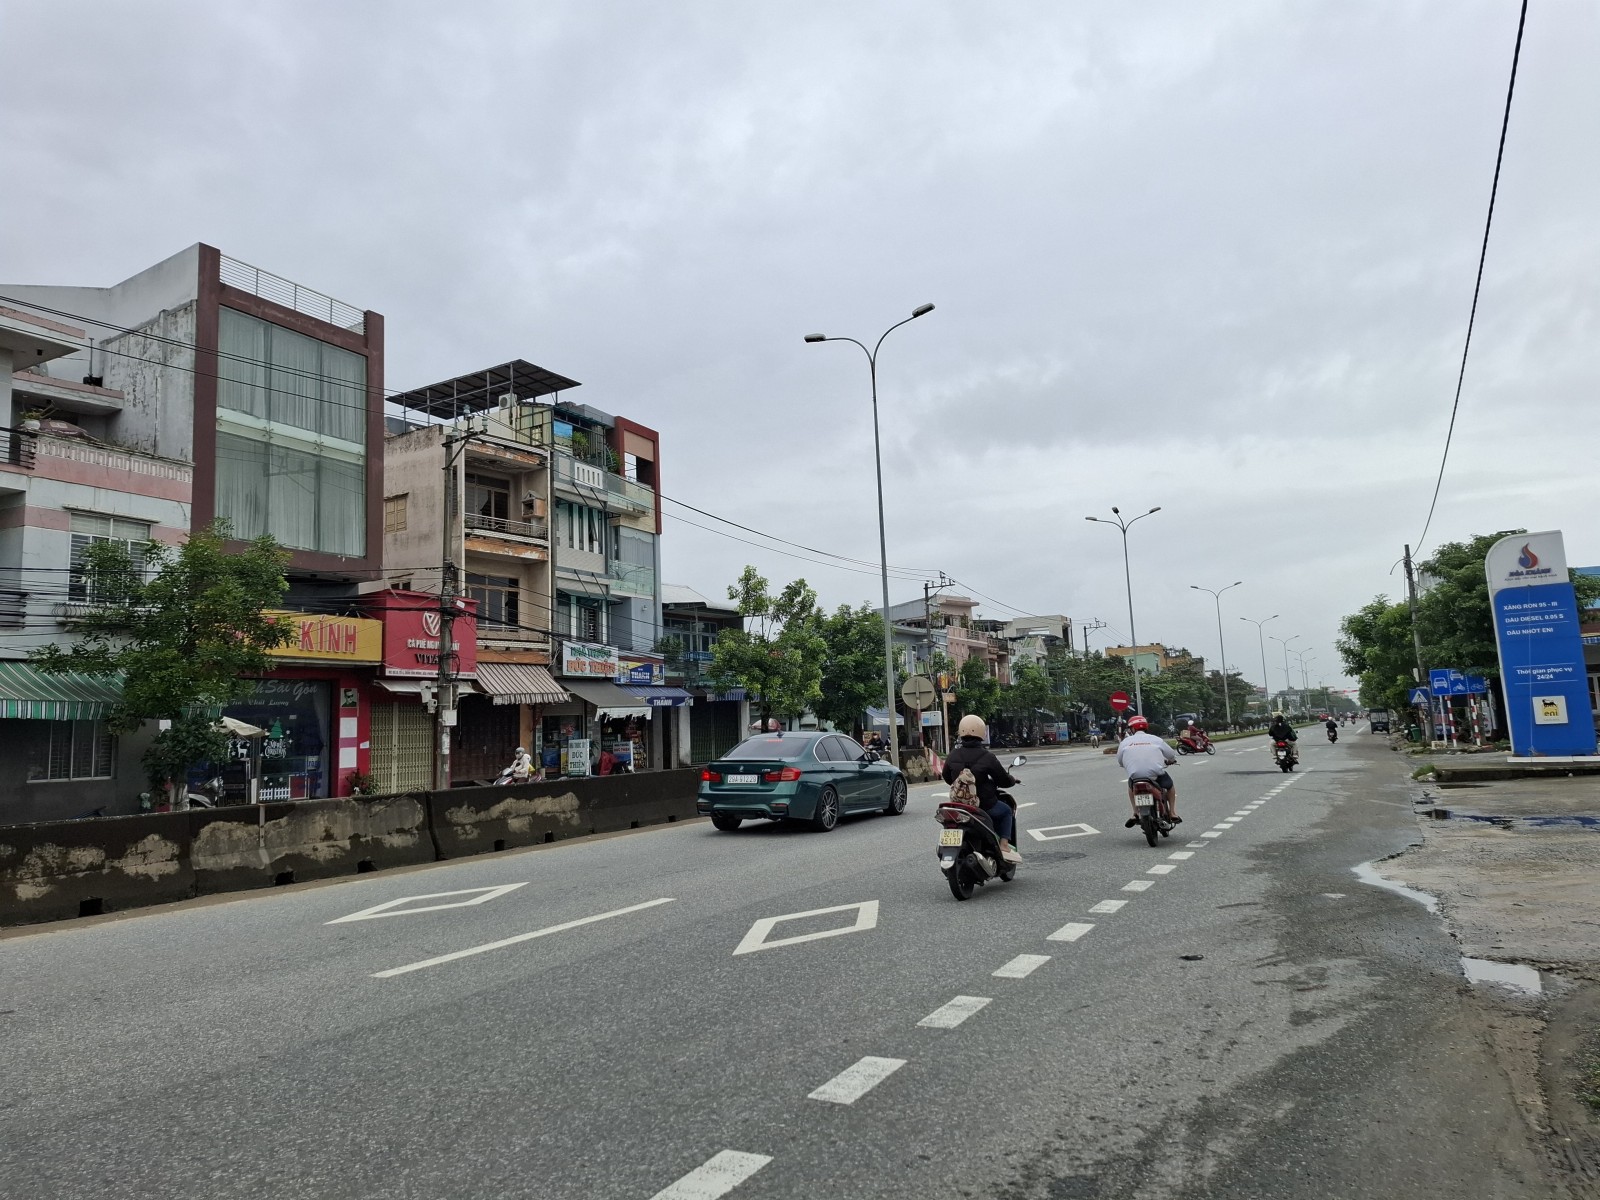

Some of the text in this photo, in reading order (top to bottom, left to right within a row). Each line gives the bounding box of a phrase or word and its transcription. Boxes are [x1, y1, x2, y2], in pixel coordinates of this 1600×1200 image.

[299, 613, 357, 653] KÍNH
[1532, 667, 1546, 675] gian
[1544, 708, 1558, 717] eni
